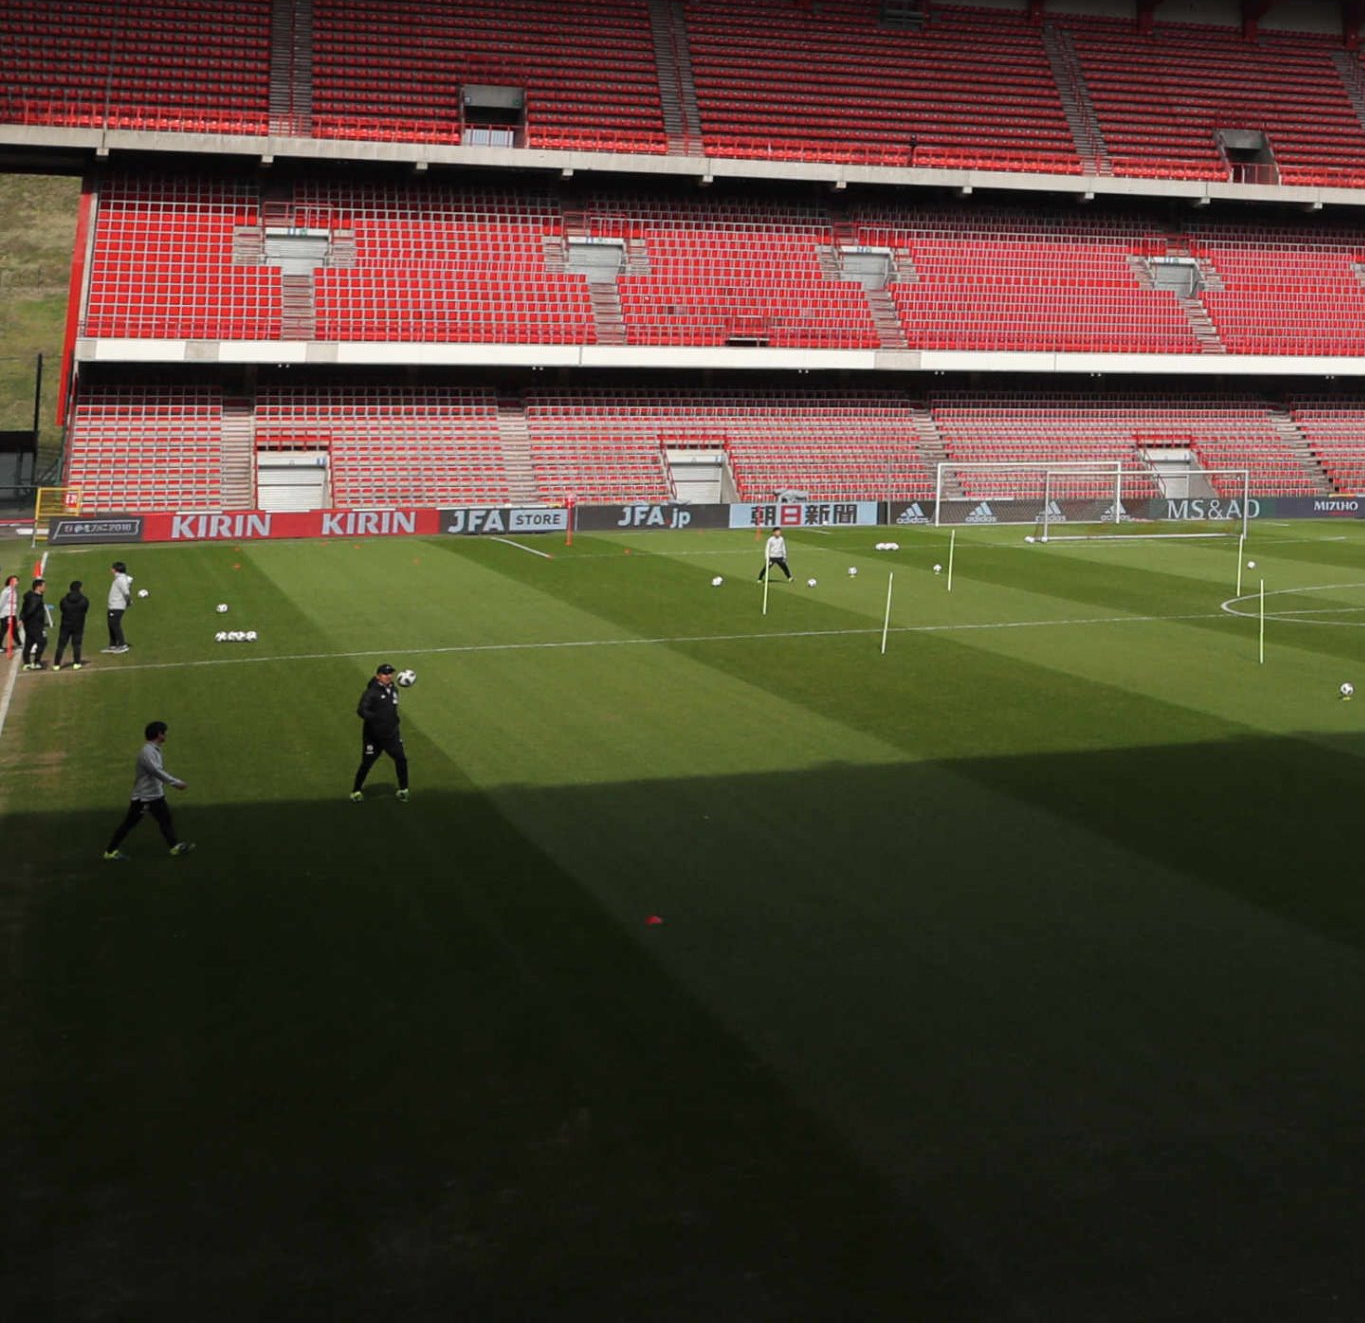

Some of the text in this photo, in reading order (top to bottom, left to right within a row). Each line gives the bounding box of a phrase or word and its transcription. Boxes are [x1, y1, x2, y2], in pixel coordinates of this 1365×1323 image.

[751, 504, 858, 526] 朝日新聞
[1167, 499, 1260, 520] MS&AD
[1314, 500, 1359, 511] MIZUHO
[171, 513, 271, 539] KIRIN
[321, 511, 416, 535] KIRIN
[447, 510, 561, 533] JFA STORE
[617, 506, 691, 528] JFA.jp
[965, 514, 997, 523] adidas
